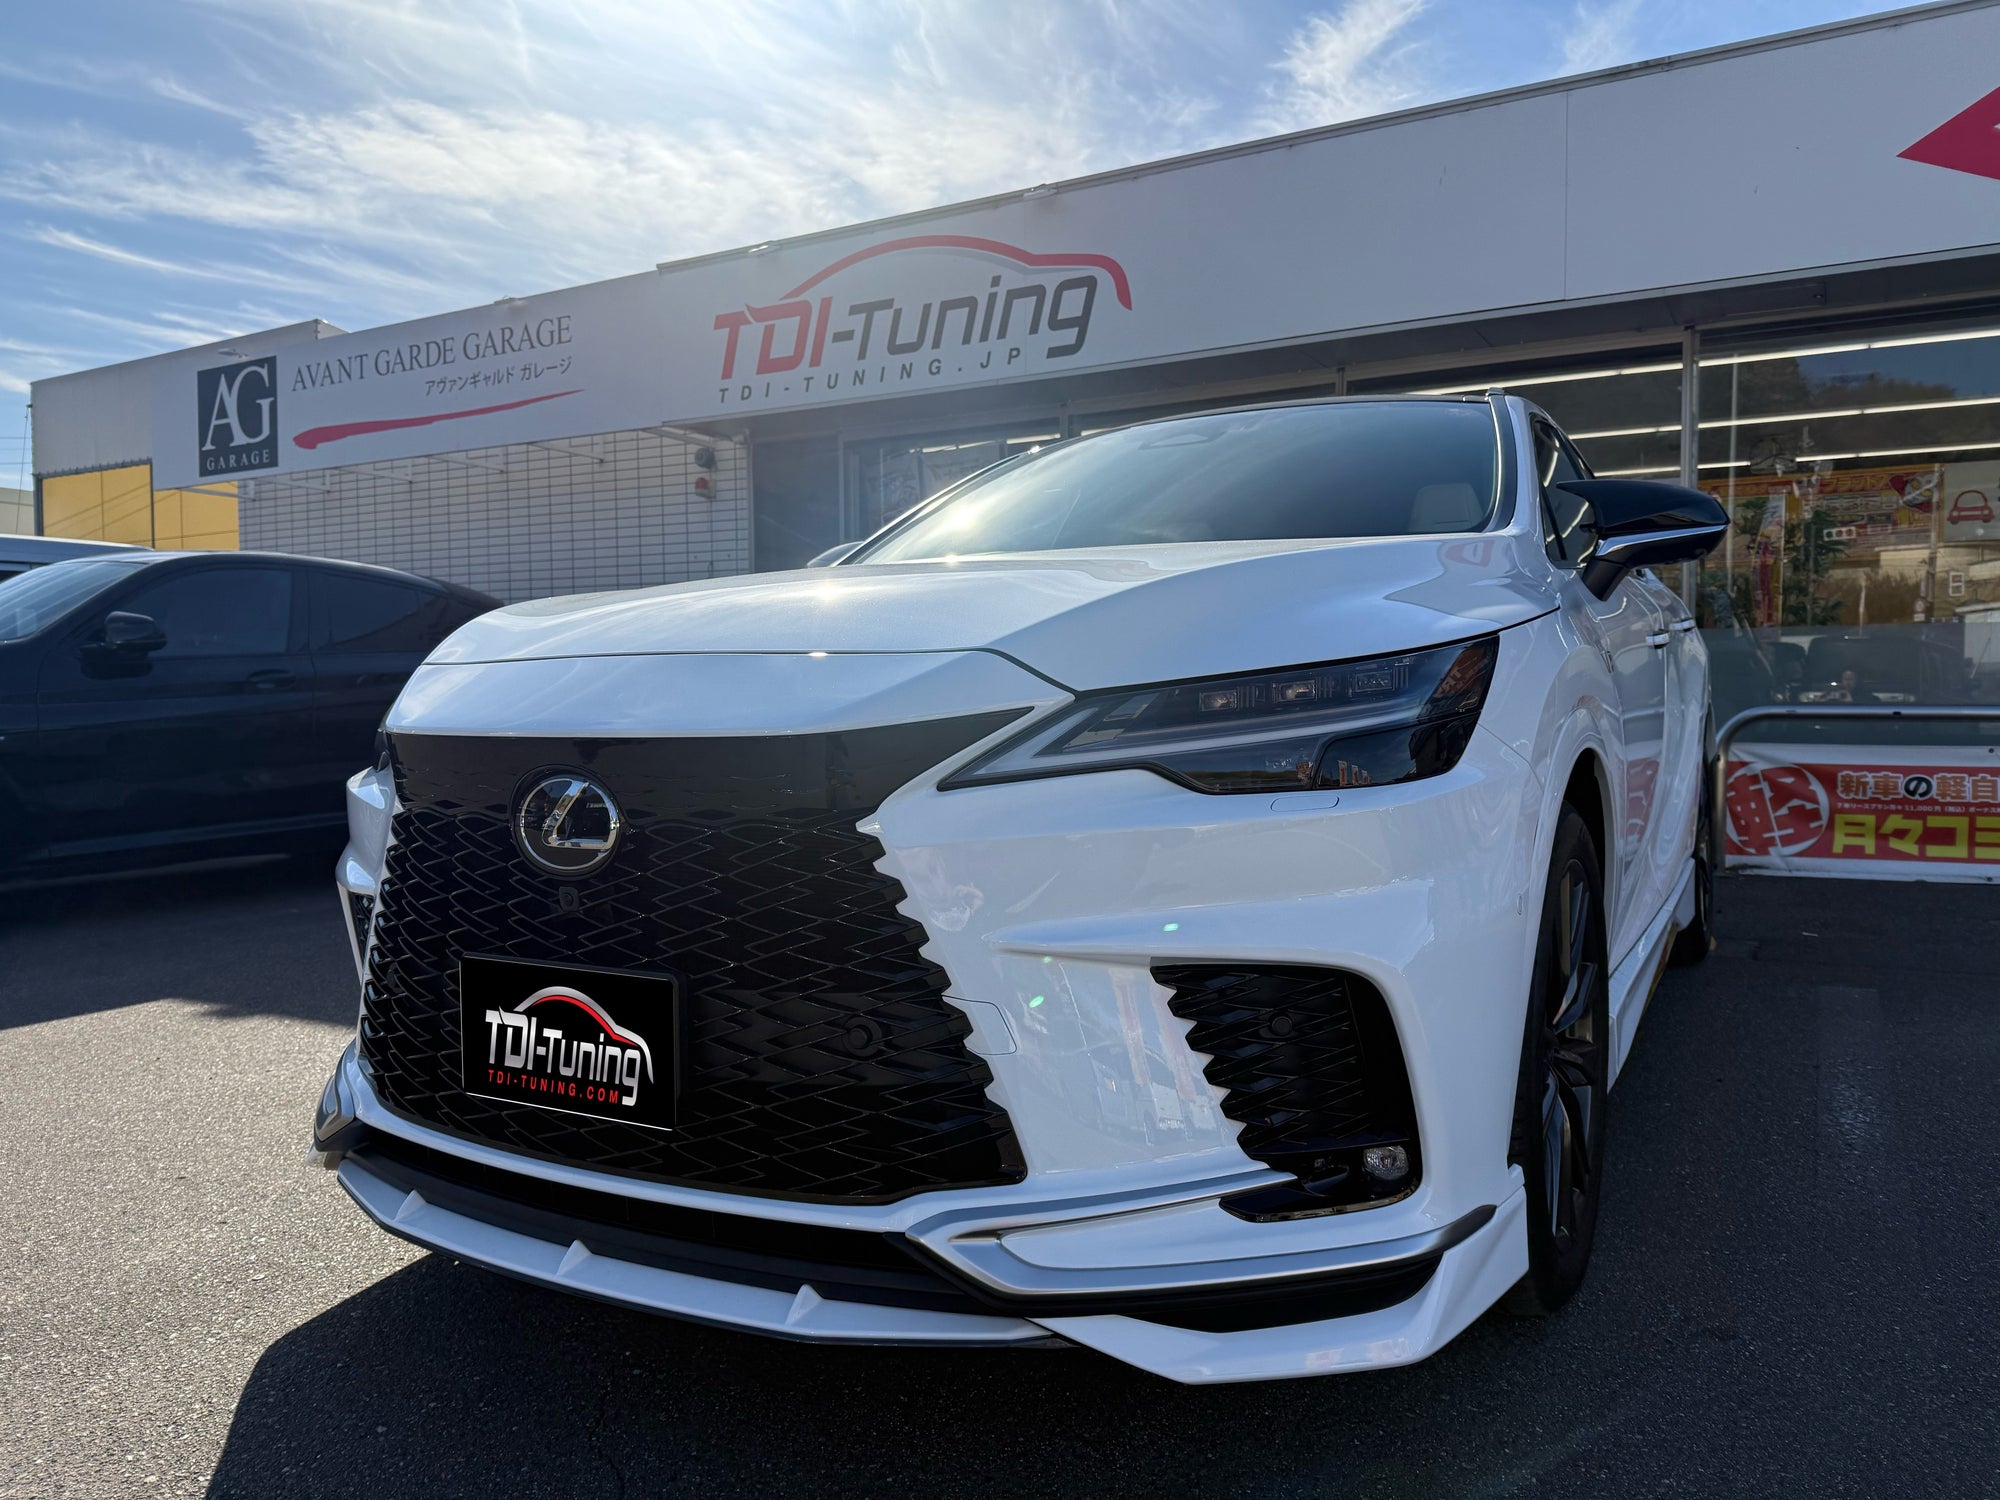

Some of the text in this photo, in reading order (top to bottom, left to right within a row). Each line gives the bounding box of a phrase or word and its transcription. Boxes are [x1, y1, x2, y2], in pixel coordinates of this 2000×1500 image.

[292, 315, 573, 393] AVANT GARDE GARAGE
[713, 275, 1098, 380] TDI-Tuning
[201, 363, 275, 452] AG
[424, 356, 573, 397] アヴァンギャルド ガレージ
[718, 346, 1022, 404] TDI-TUNING.JP
[206, 449, 271, 472] GARAGE
[485, 1006, 641, 1107] TDI-Tuning
[487, 1069, 619, 1105] TDI-TUNING.COM
